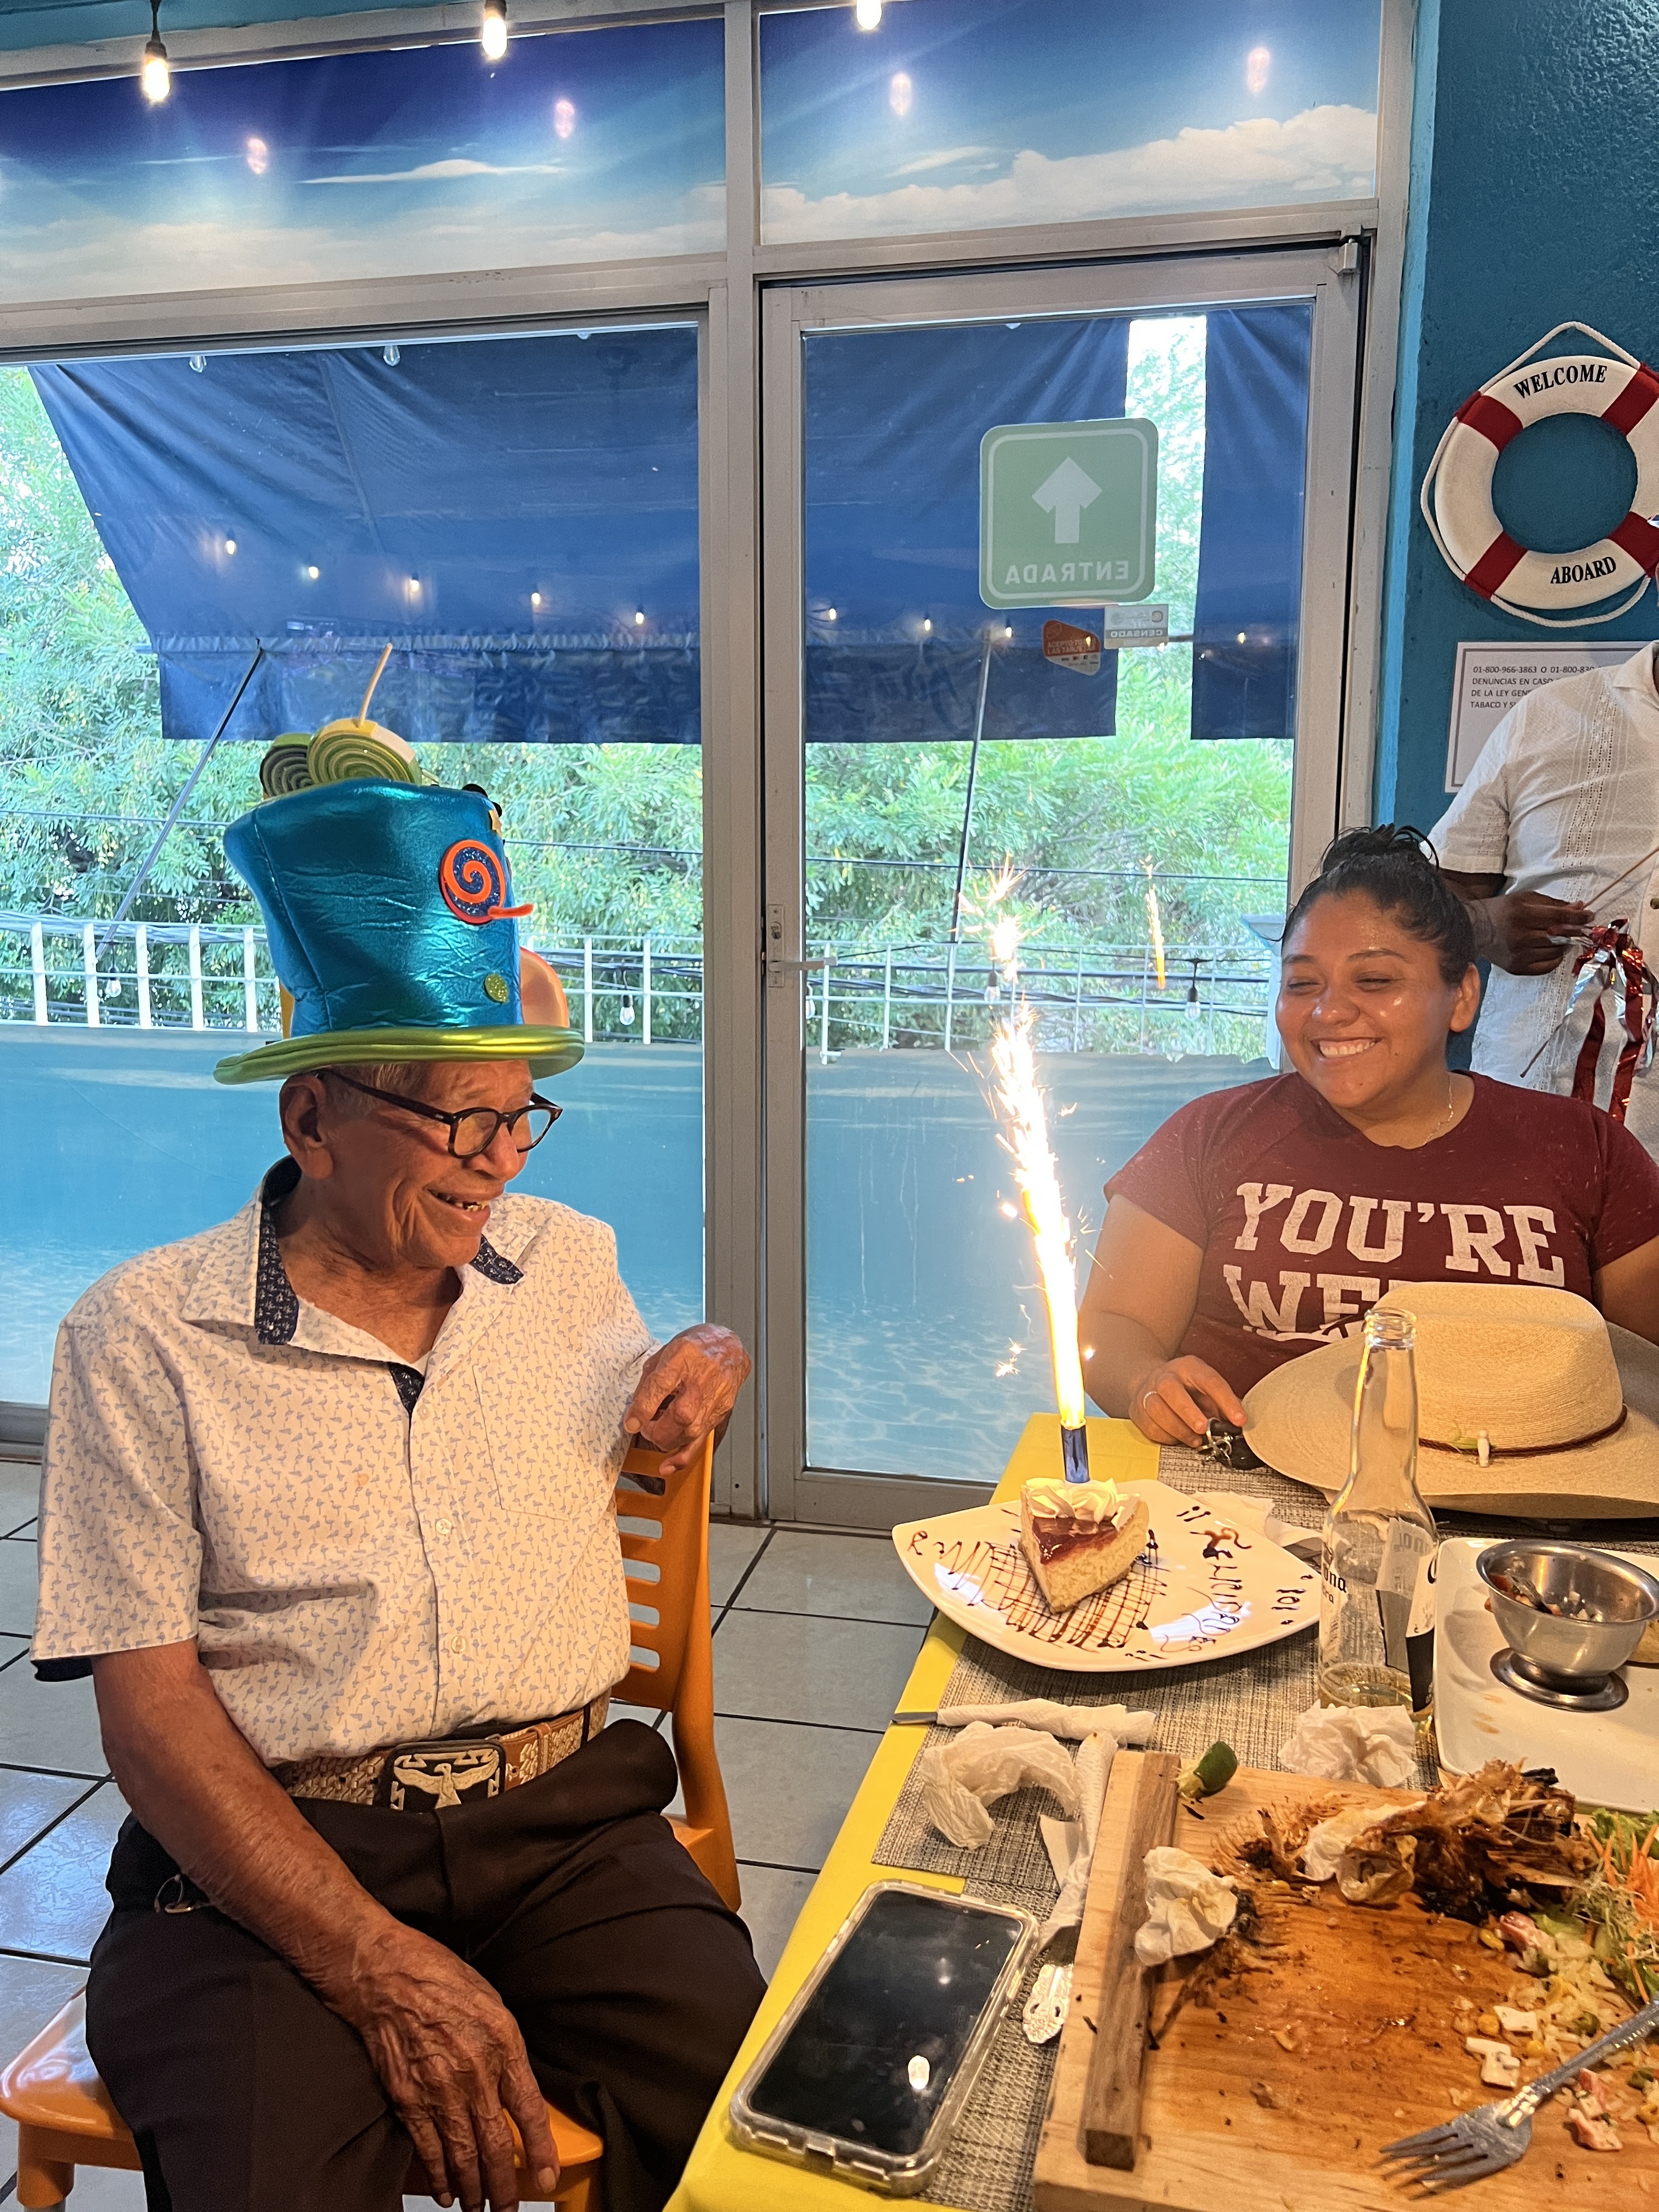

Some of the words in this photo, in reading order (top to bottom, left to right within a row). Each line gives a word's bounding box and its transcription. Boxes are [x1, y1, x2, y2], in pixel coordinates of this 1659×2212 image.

[1514, 364, 1607, 399] WELCOME
[1550, 556, 1617, 584] ABOARD
[1234, 1182, 1565, 1286] YOU'RE
[1223, 1264, 1414, 1343] WE
